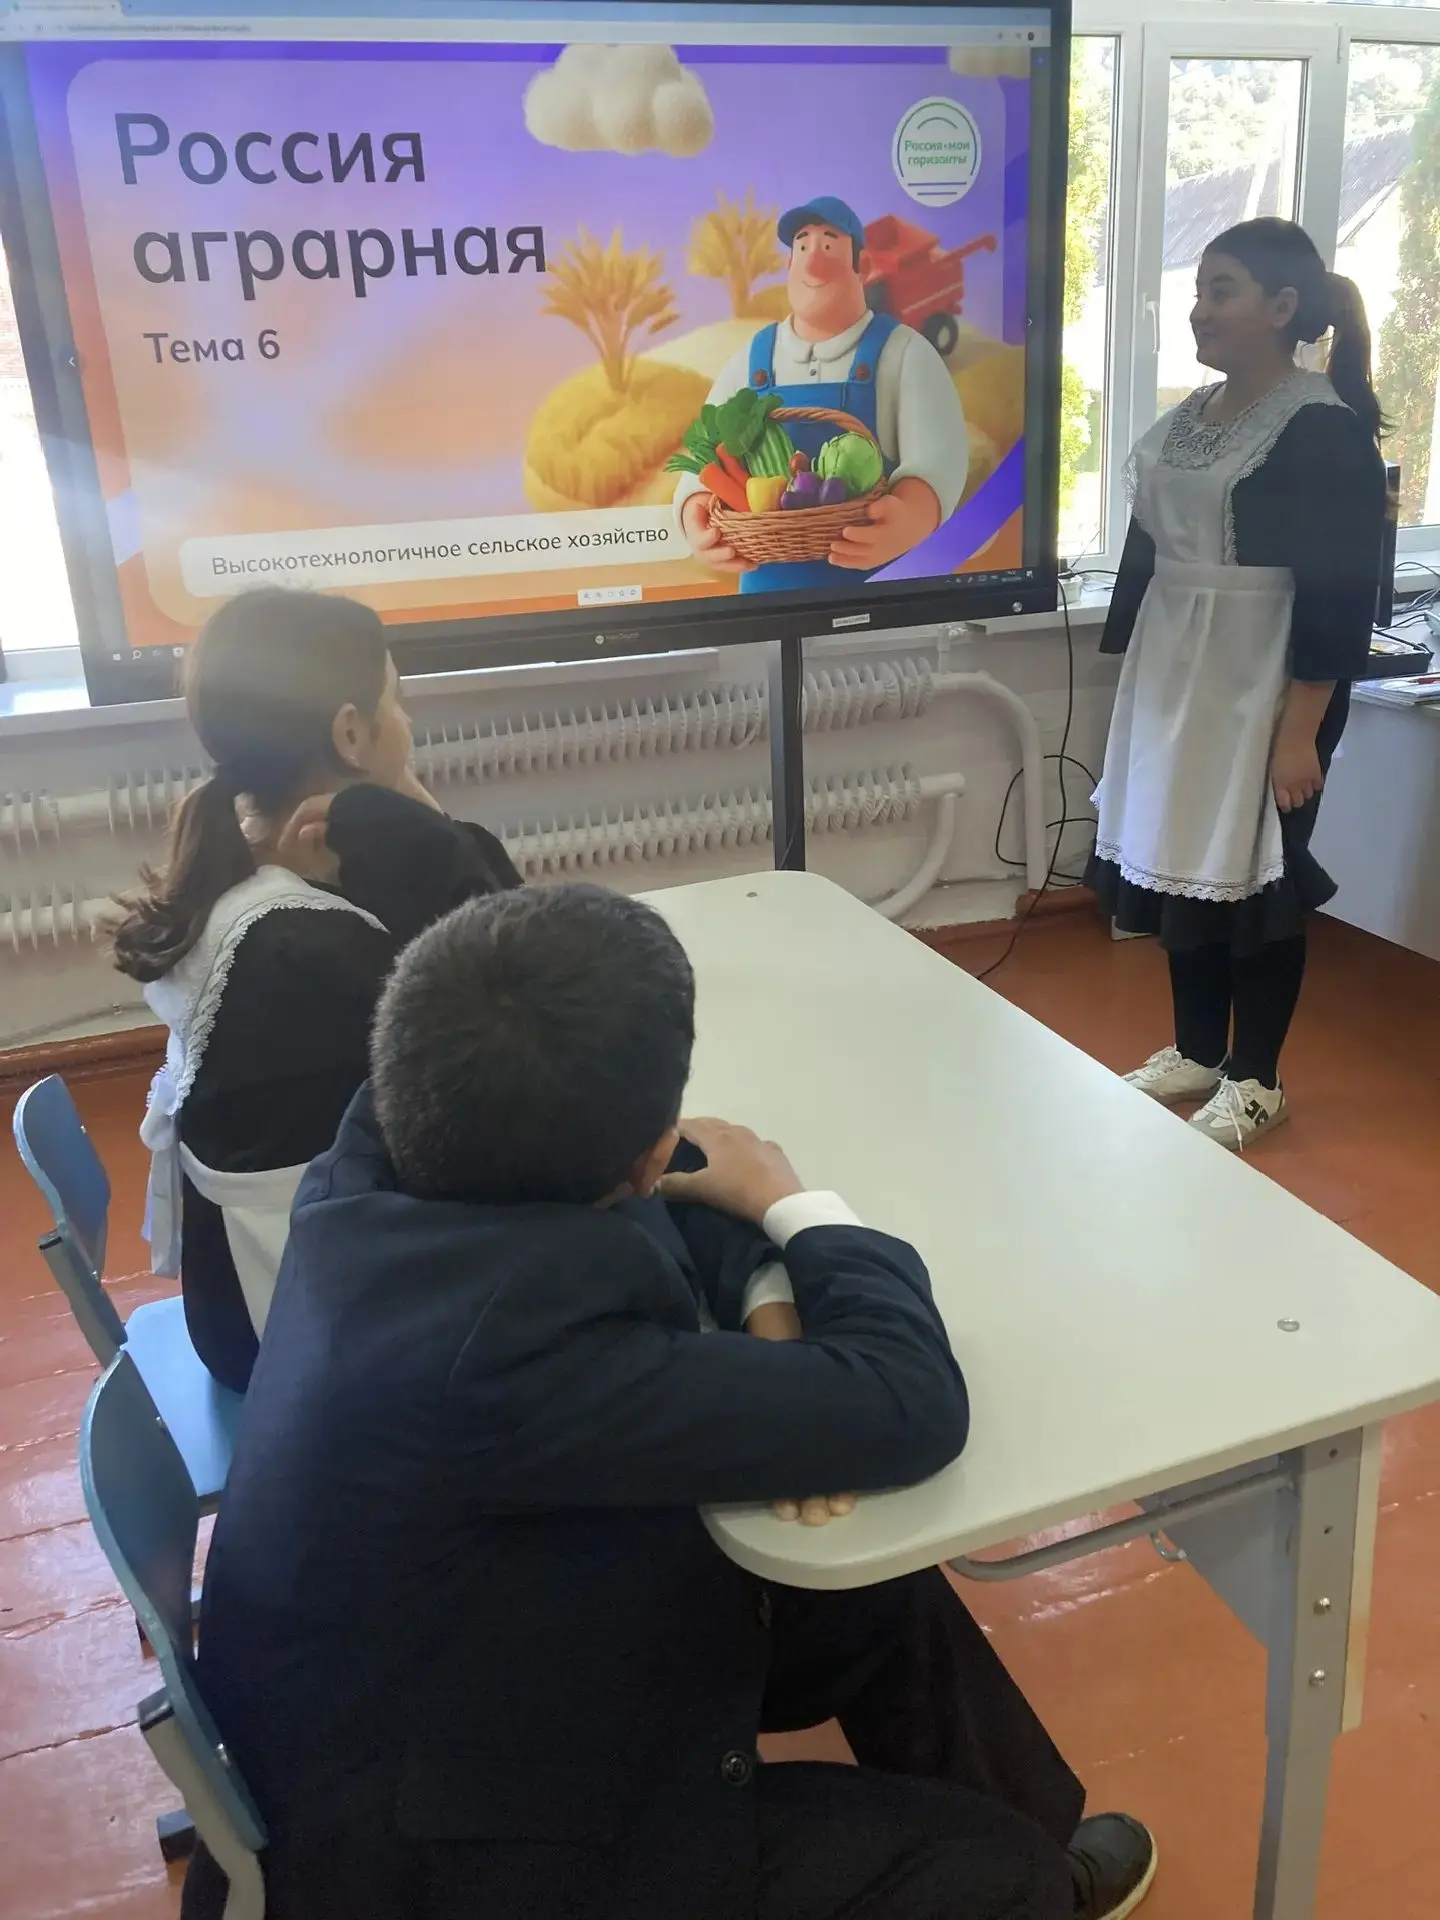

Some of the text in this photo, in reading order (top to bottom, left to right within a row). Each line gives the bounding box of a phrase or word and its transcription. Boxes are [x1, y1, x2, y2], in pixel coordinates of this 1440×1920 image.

[114, 112, 426, 185] Россия
[907, 156, 967, 168] горизонты
[132, 224, 548, 301] аграрная
[143, 328, 281, 364] Тема 6
[211, 527, 670, 575] Высокотехнологичное сельское хозяйство
